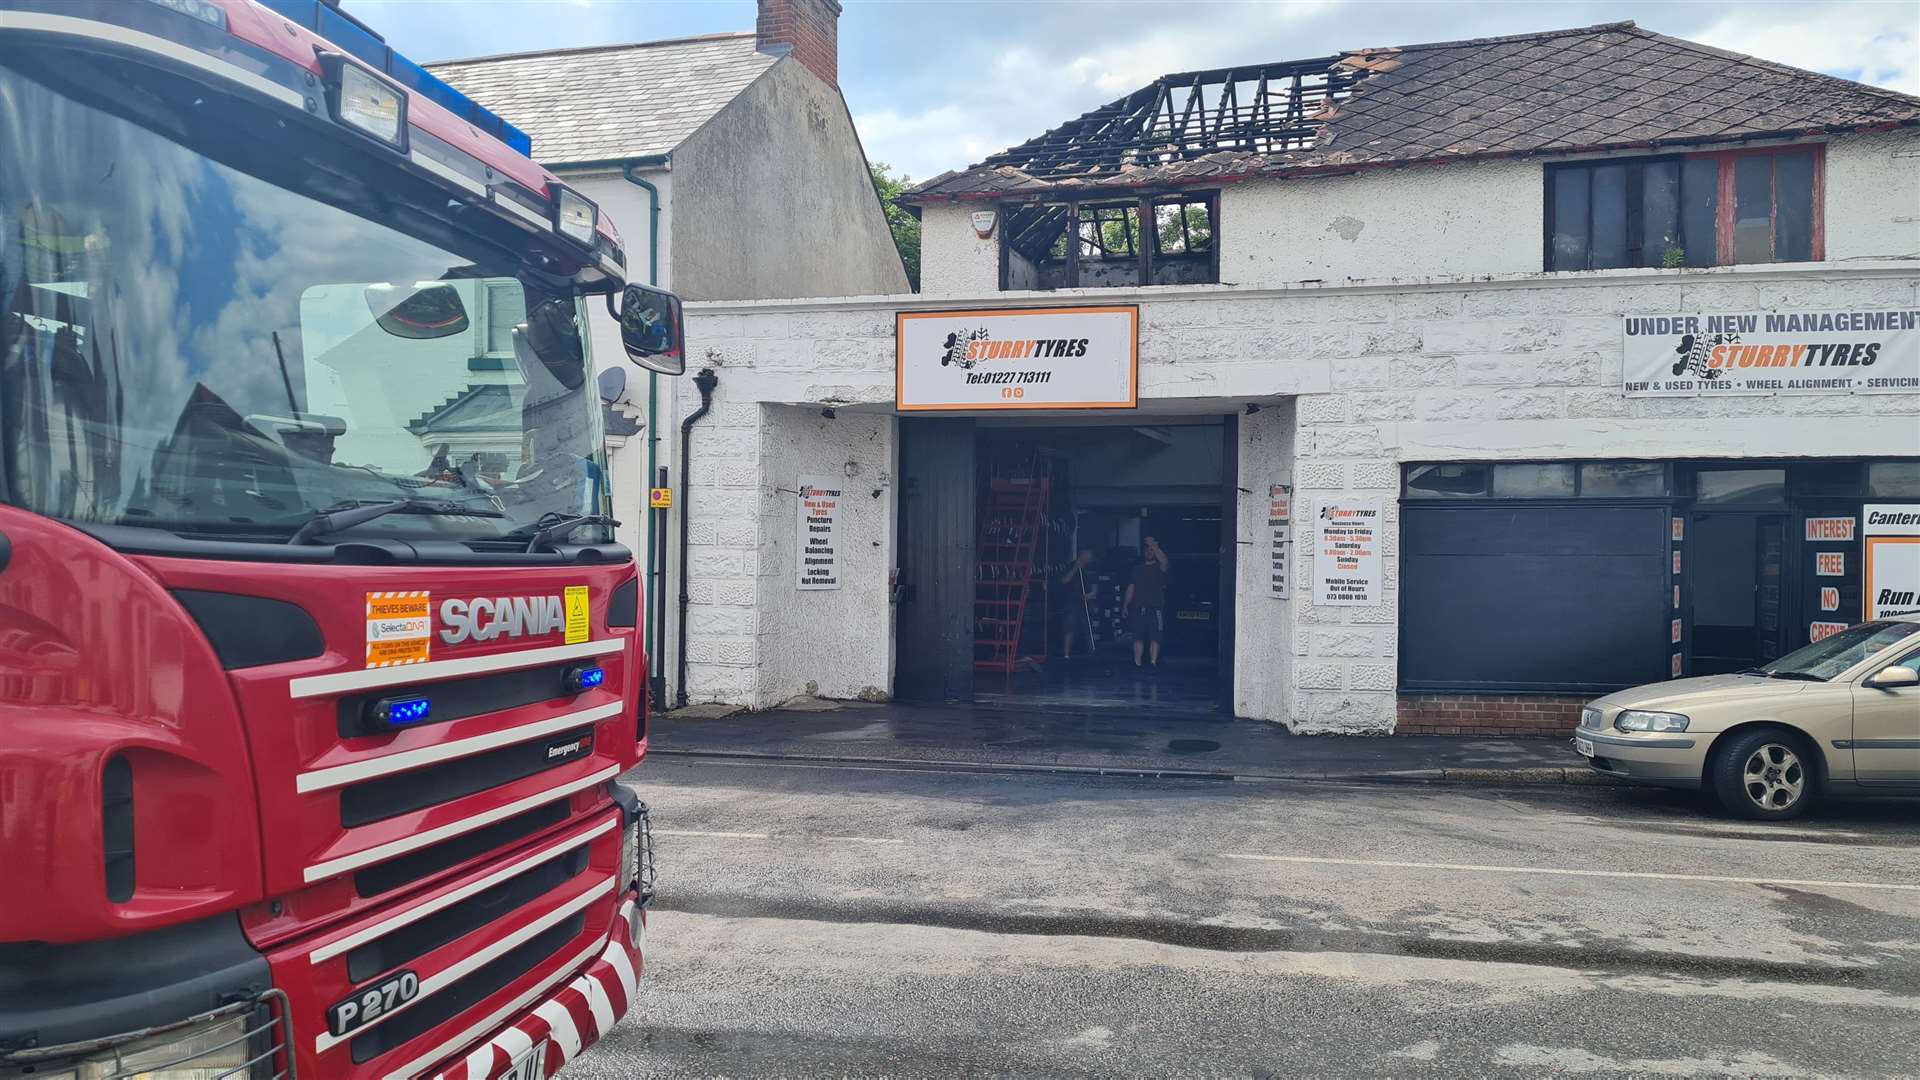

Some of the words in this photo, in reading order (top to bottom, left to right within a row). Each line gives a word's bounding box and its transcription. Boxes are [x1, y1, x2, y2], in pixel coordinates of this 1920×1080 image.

[1625, 316, 1699, 336] UNDER
[1707, 314, 1757, 334] NEW
[966, 338, 1089, 360] STURRYTYRES
[1707, 342, 1882, 369] STURRYTYRES
[966, 372, 1016, 385] Tel:01227
[1017, 371, 1051, 384] 713111
[1625, 382, 1649, 391] NEW
[1653, 382, 1661, 390] &
[1665, 381, 1693, 390] USED
[1697, 380, 1732, 390] TYRES
[1746, 379, 1784, 389] WHEEL
[1787, 379, 1853, 389] ALIGNMENT
[806, 516, 832, 524] Puncture
[809, 525, 831, 533] Repairs
[1323, 528, 1347, 536] Monday
[1354, 528, 1373, 536] Friday
[1807, 519, 1854, 539] INTEREST
[805, 546, 834, 555] Balancing
[804, 557, 834, 566] Alignment
[1818, 554, 1842, 573] FREE
[807, 568, 829, 576] Locking
[1823, 589, 1837, 609] NO
[1877, 588, 1915, 605] Run
[439, 595, 565, 644] SCANIA
[337, 1001, 359, 1035] P
[362, 972, 418, 1022] 270
